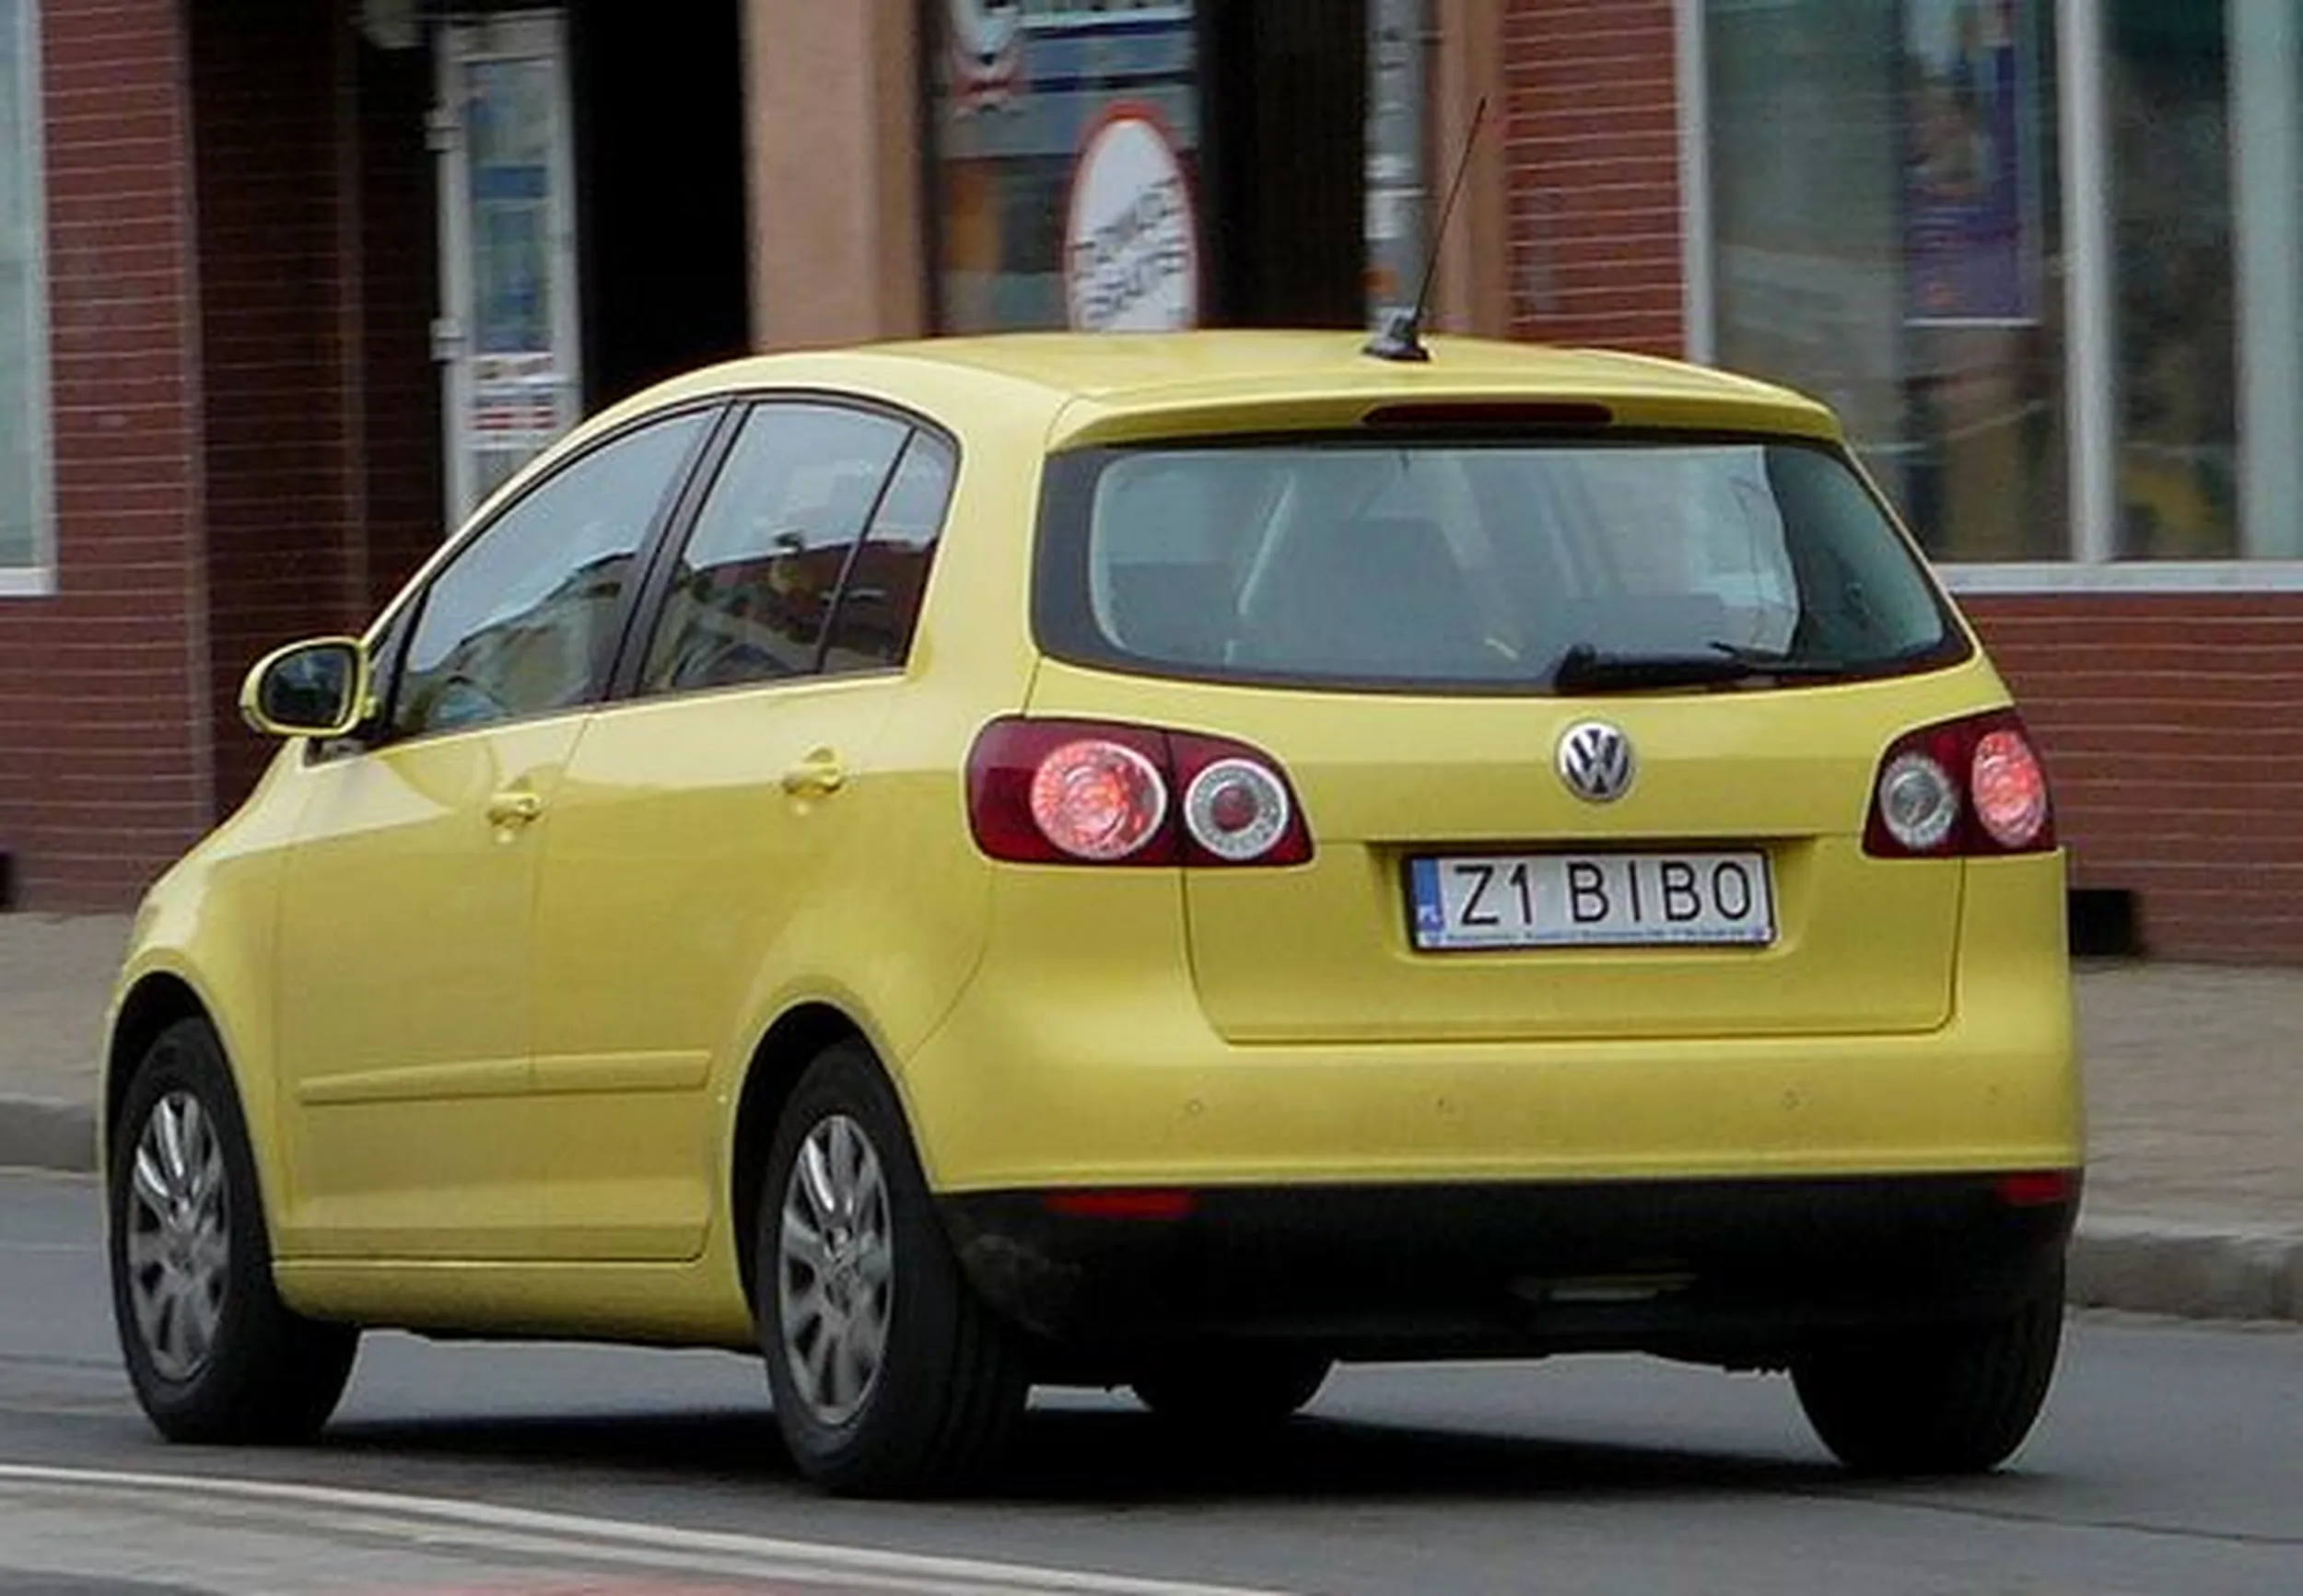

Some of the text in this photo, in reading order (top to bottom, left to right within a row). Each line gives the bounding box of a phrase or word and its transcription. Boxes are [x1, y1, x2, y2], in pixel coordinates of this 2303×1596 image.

[1561, 724, 1629, 798] VW
[1454, 860, 1752, 926] Z1 BIBO
